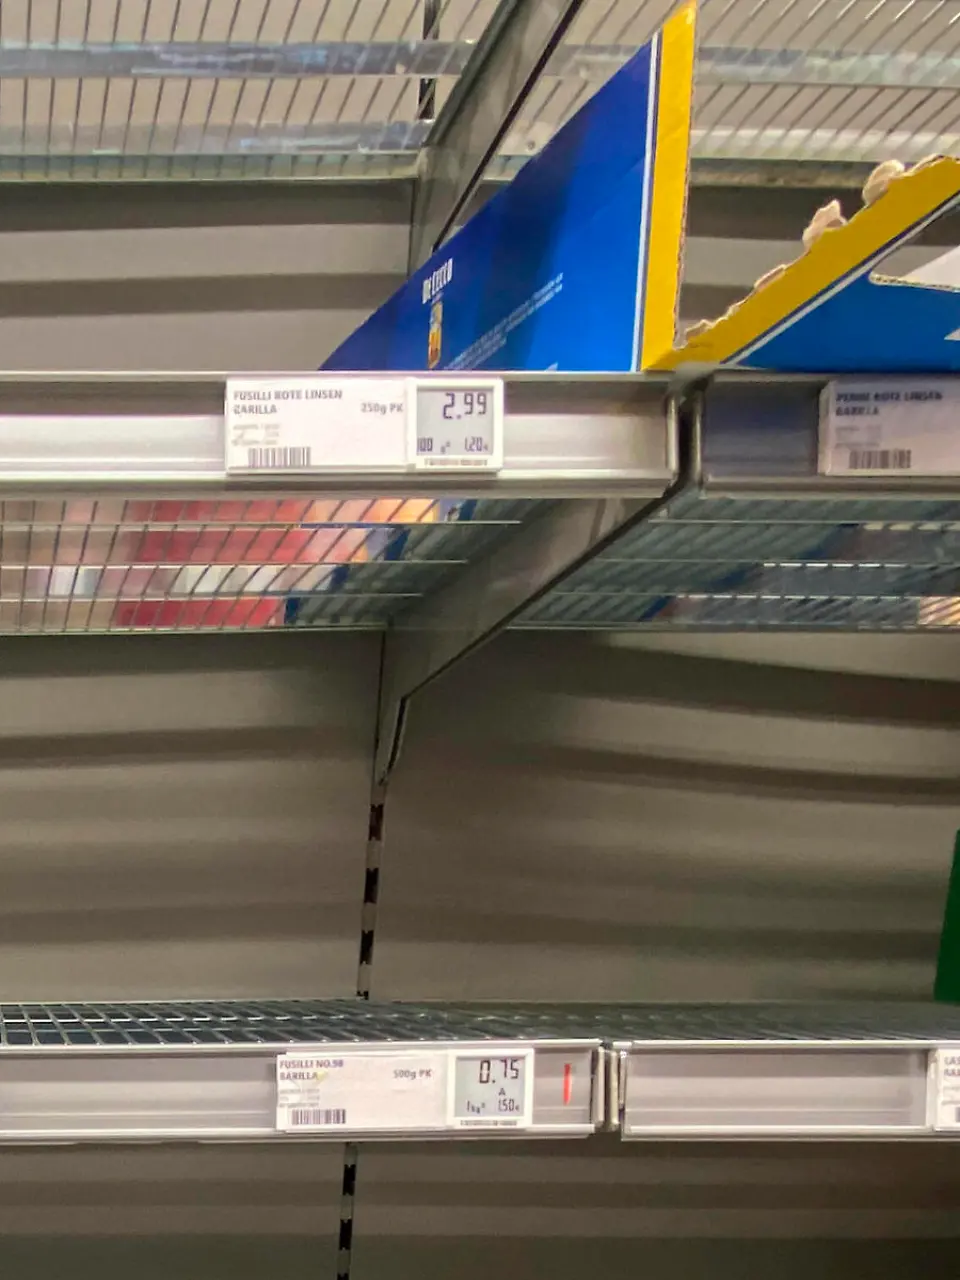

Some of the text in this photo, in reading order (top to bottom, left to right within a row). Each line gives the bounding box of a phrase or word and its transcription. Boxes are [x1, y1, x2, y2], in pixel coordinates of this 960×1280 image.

[233, 389, 343, 401] FUSILLI ROTE LINSEN
[389, 401, 404, 413] PK
[442, 391, 487, 420] 2.99
[279, 1060, 314, 1069] FUSILLI
[393, 1068, 432, 1080] 500g PK
[479, 1059, 520, 1084] 0.75
